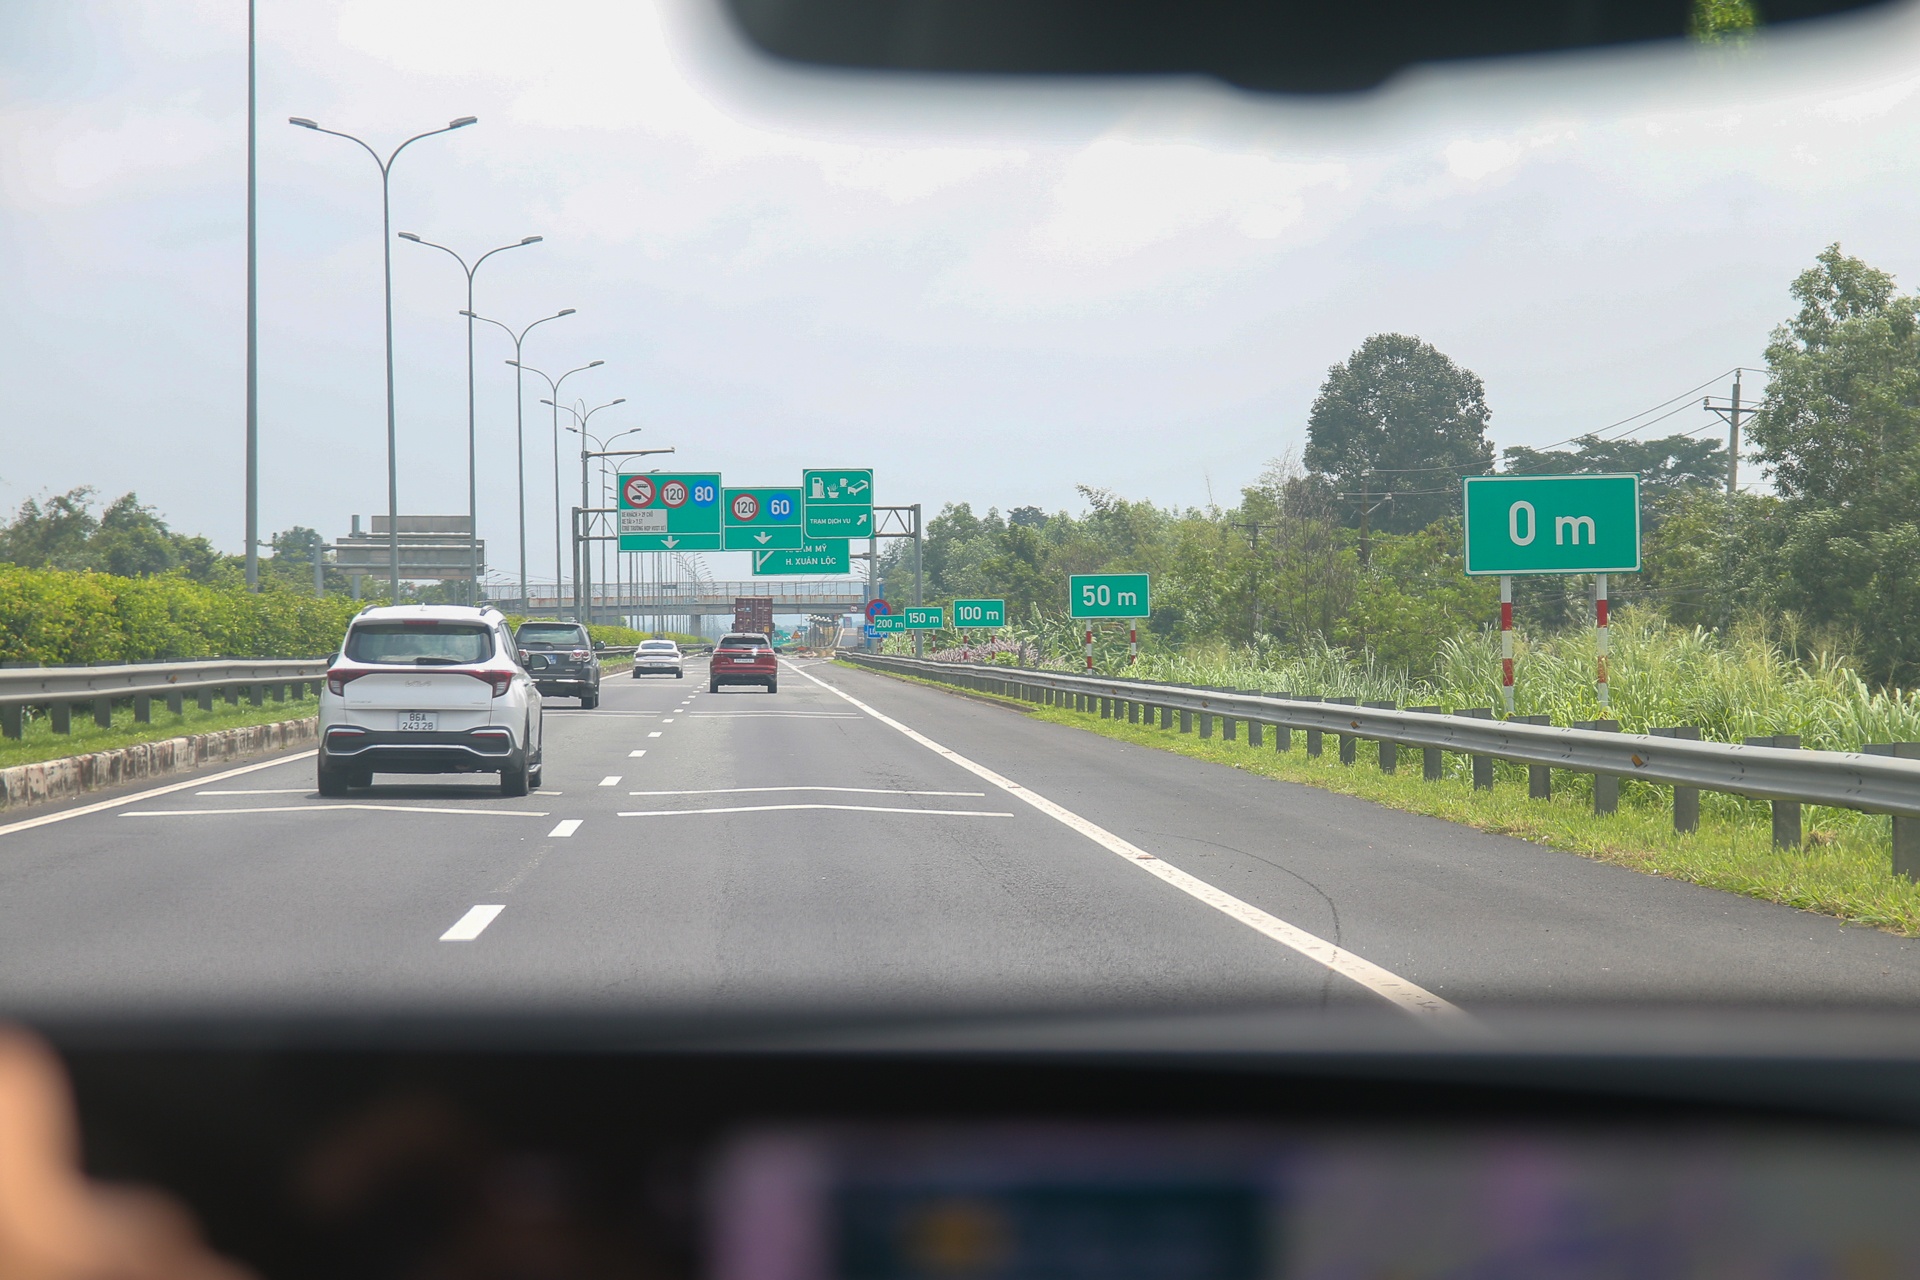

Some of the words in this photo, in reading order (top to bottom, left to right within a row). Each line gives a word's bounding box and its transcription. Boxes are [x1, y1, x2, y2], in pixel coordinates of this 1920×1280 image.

[665, 488, 684, 501] 120
[695, 486, 713, 502] 80
[736, 501, 755, 514] 120
[771, 500, 790, 515] 60
[1509, 500, 1536, 547] 0
[1555, 515, 1596, 546] m
[815, 543, 827, 553] MỸ
[785, 558, 794, 566] H.
[820, 555, 837, 566] LỘC
[1082, 584, 1111, 607] 50
[1117, 589, 1137, 606] m
[908, 612, 926, 624] 150
[929, 615, 940, 623] m
[958, 606, 982, 620] 100
[986, 610, 999, 620] m
[876, 619, 893, 628] 200
[409, 713, 427, 721] 86A
[402, 722, 434, 731] 243.28
